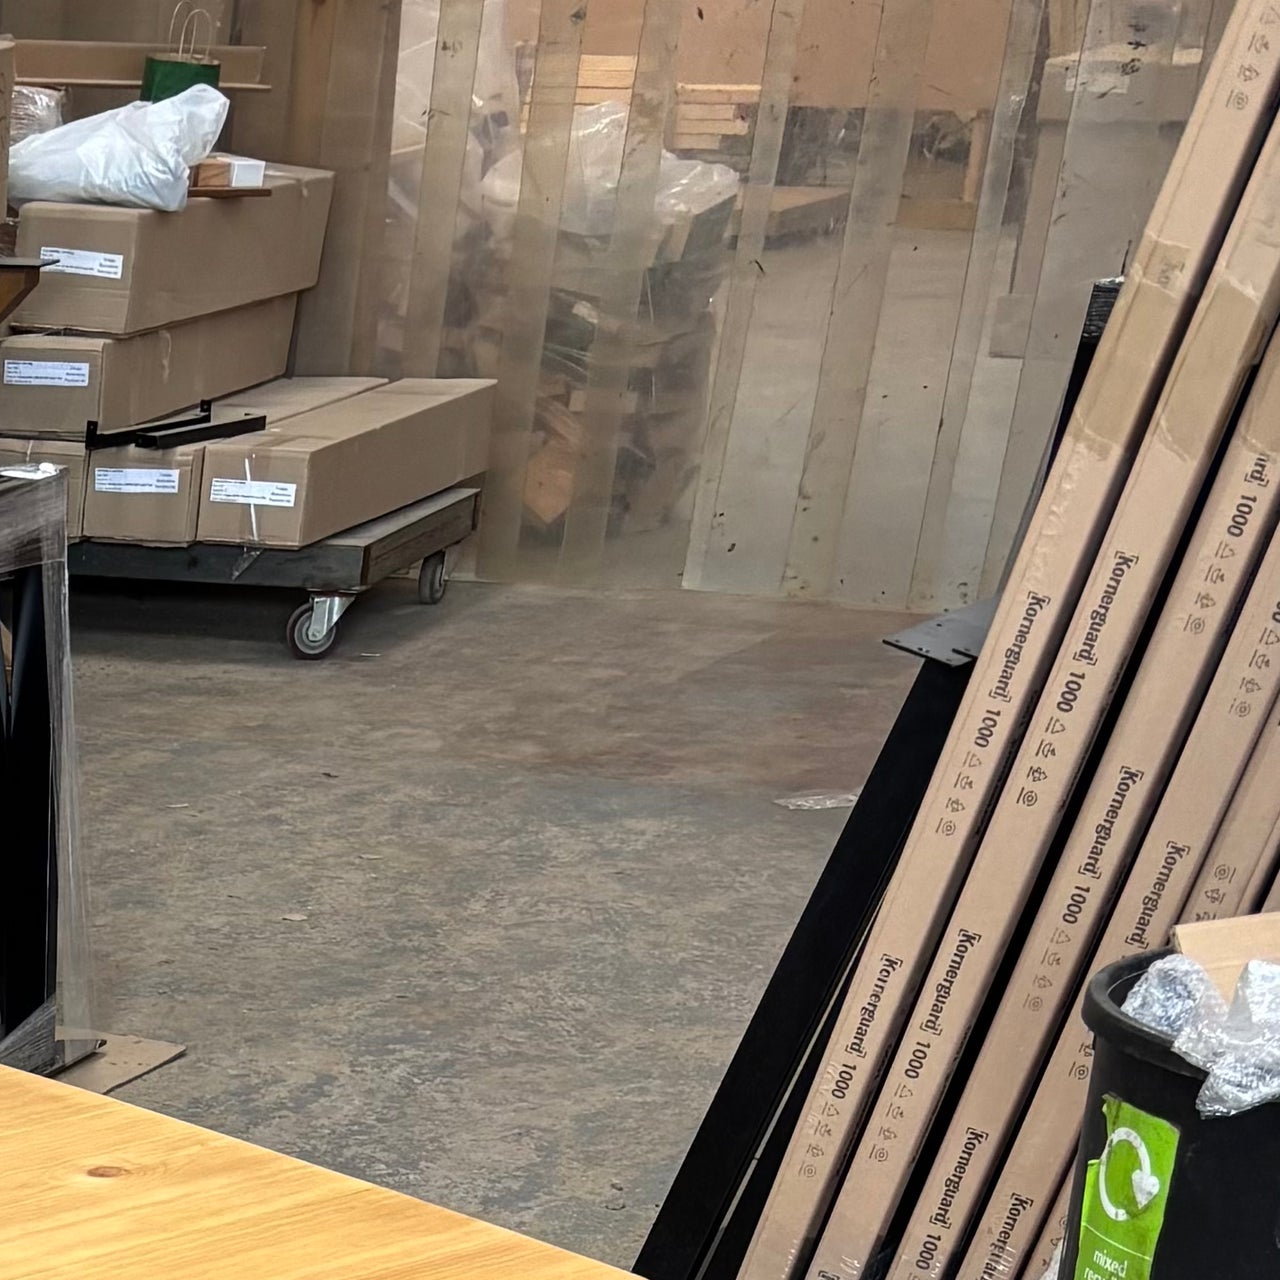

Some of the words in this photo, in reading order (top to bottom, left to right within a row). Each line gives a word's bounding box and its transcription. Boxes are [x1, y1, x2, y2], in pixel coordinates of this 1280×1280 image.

[1226, 494, 1257, 538] 1000
[1056, 671, 1086, 713] 1000
[974, 709, 1001, 748] 1000
[1062, 885, 1090, 924] 1000
[904, 1041, 931, 1079] 1000
[831, 1063, 857, 1099] 1000
[916, 1233, 942, 1270] 1000
[1093, 1249, 1128, 1278] mixed
